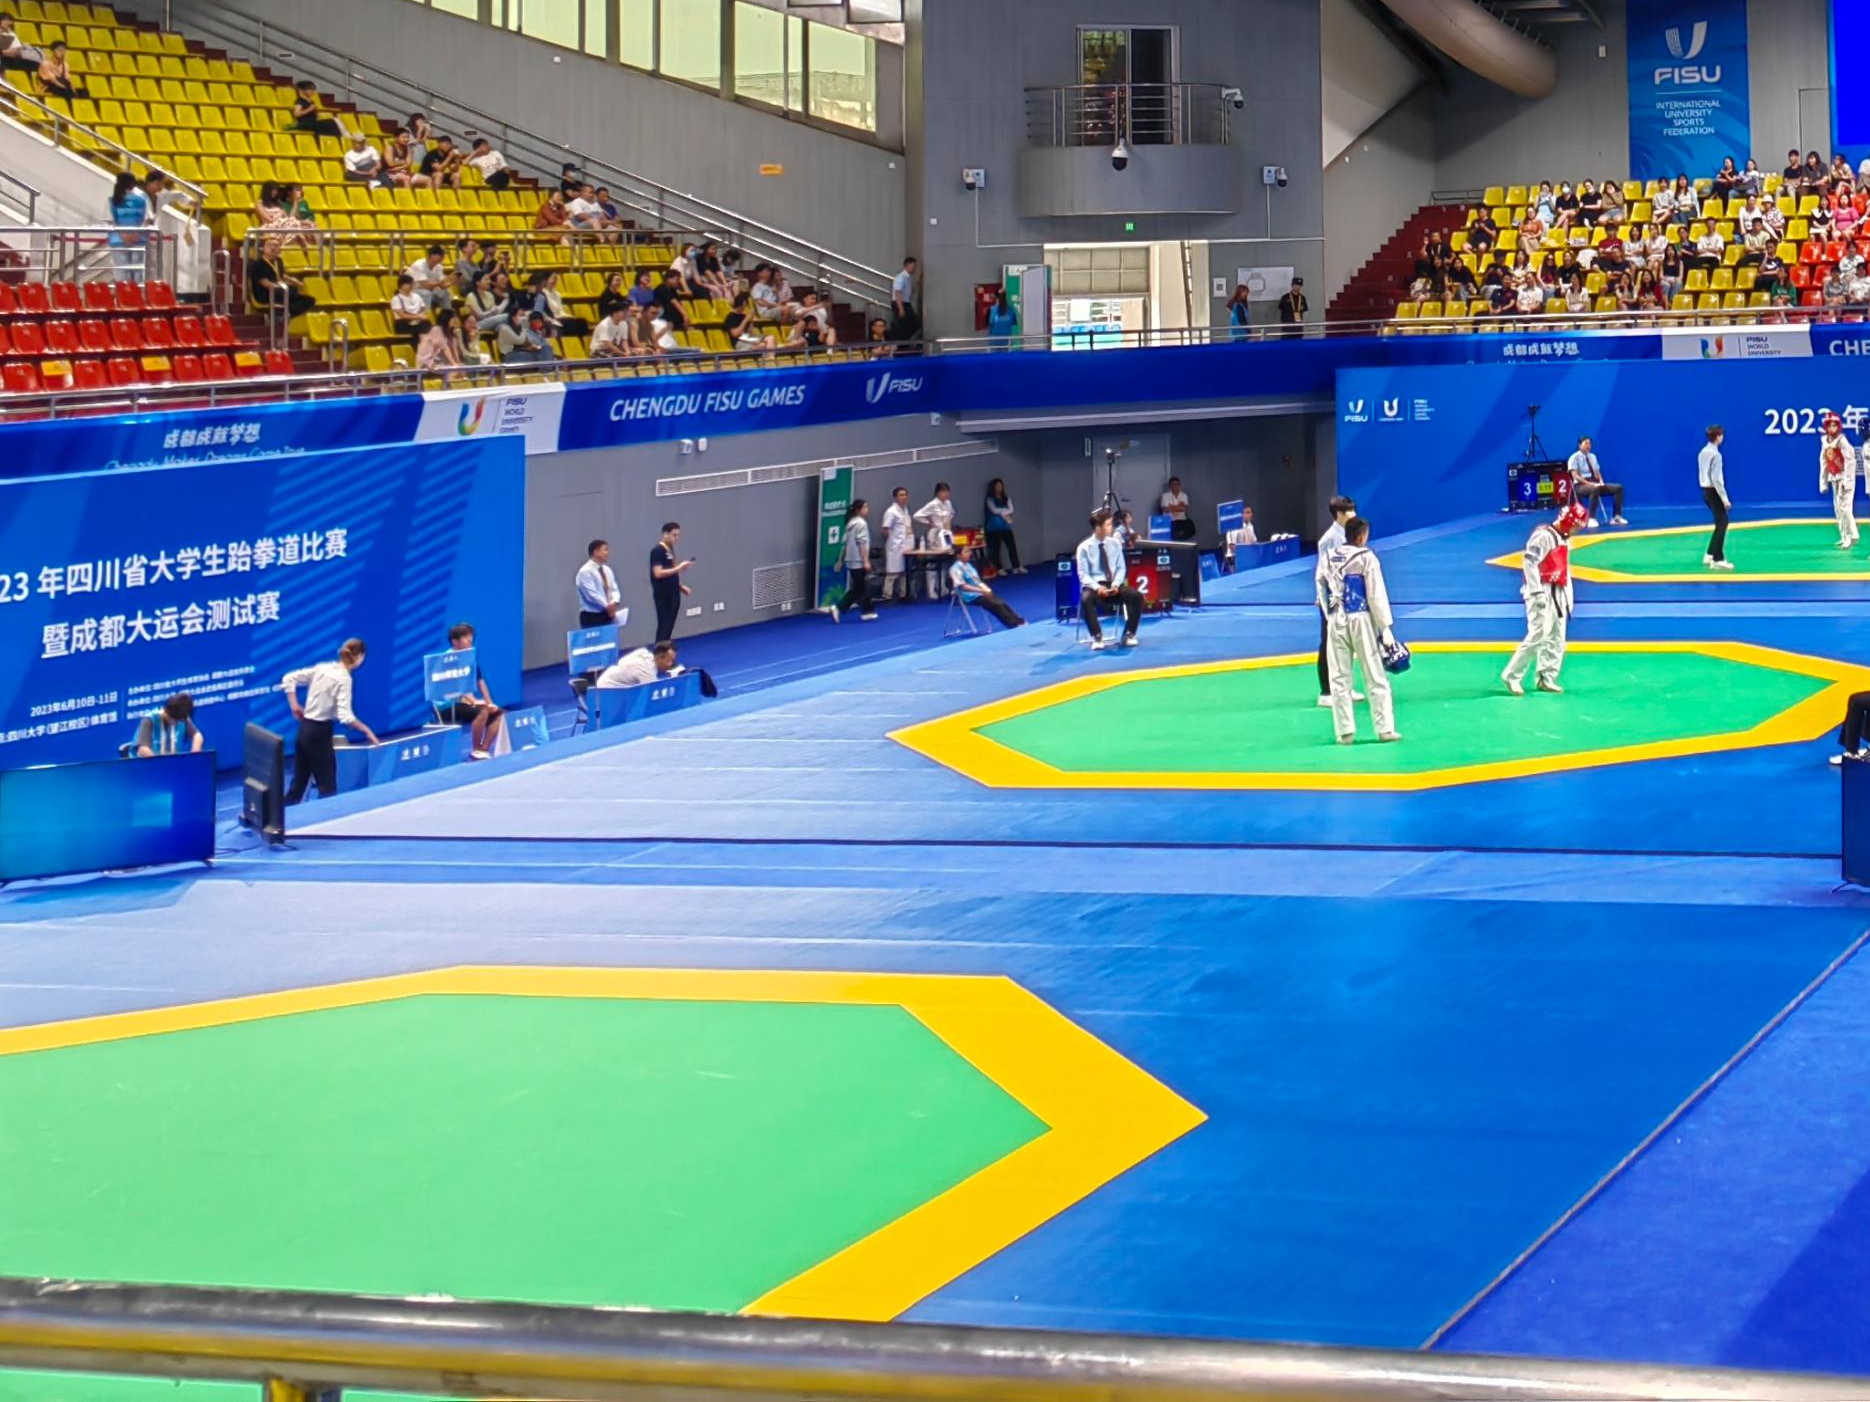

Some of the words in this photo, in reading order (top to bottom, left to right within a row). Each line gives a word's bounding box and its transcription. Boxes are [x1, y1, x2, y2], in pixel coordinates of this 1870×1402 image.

[1654, 65, 1722, 86] FISU
[1655, 99, 1721, 110] INTERNATIONAL
[1664, 108, 1713, 118] UNIVERSITY
[1673, 117, 1705, 127] SPORTS
[1663, 126, 1715, 136] FEDERATION
[888, 377, 923, 393] FISU
[609, 393, 701, 421] CHENGDU
[704, 390, 743, 412] FISU
[747, 385, 806, 407] GAMES
[1523, 482, 1532, 496] 3
[1558, 480, 1567, 493] 2
[1135, 575, 1149, 594] 2
[41, 591, 281, 659] 暨成都大运会测试赛
